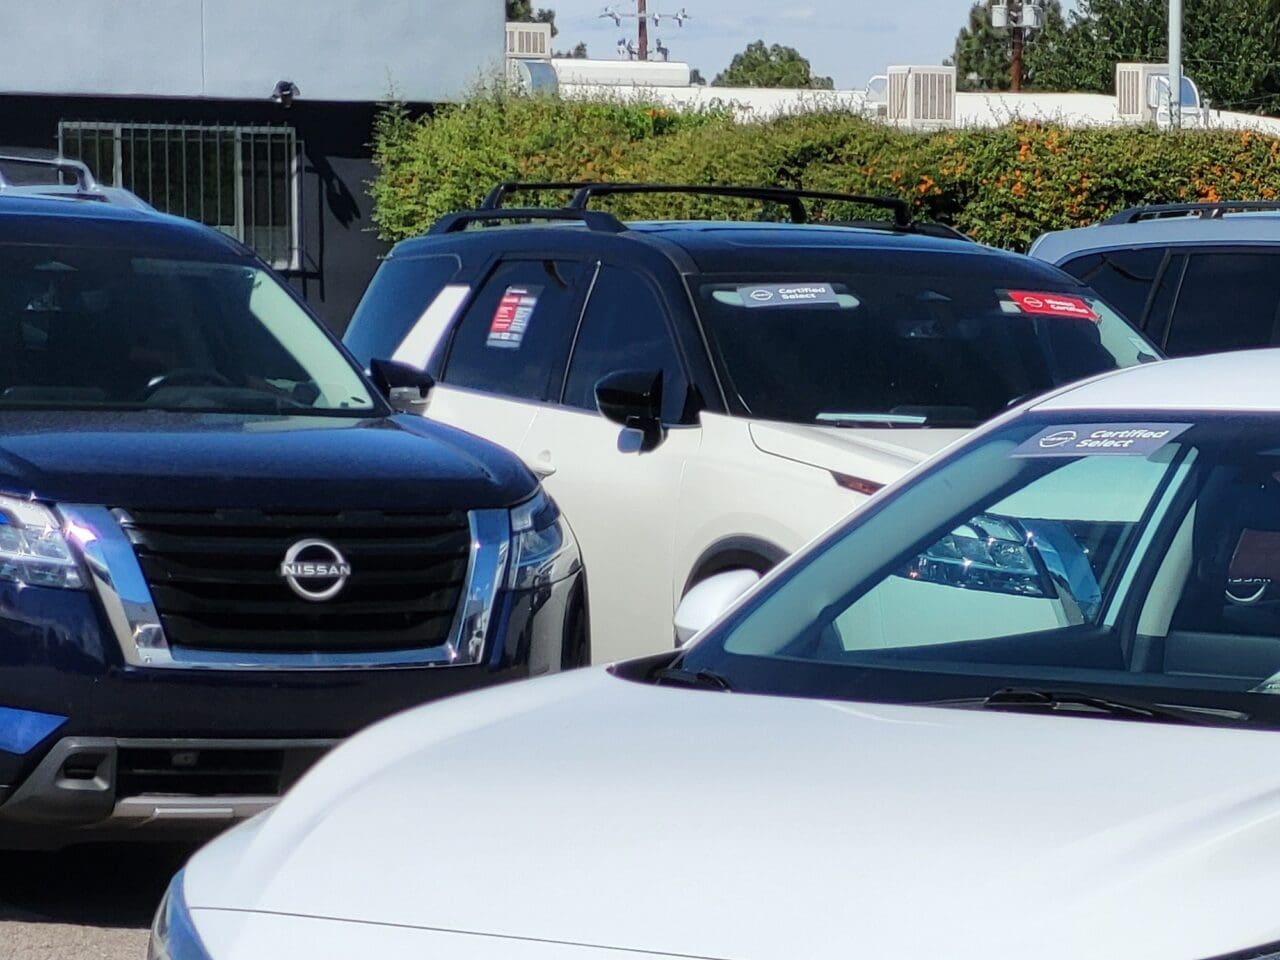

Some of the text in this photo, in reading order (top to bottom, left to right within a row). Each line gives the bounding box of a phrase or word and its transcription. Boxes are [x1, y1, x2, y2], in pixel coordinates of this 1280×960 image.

[1090, 429, 1170, 439] Certified
[1075, 439, 1134, 448] Select
[282, 564, 351, 576] NISSAN
